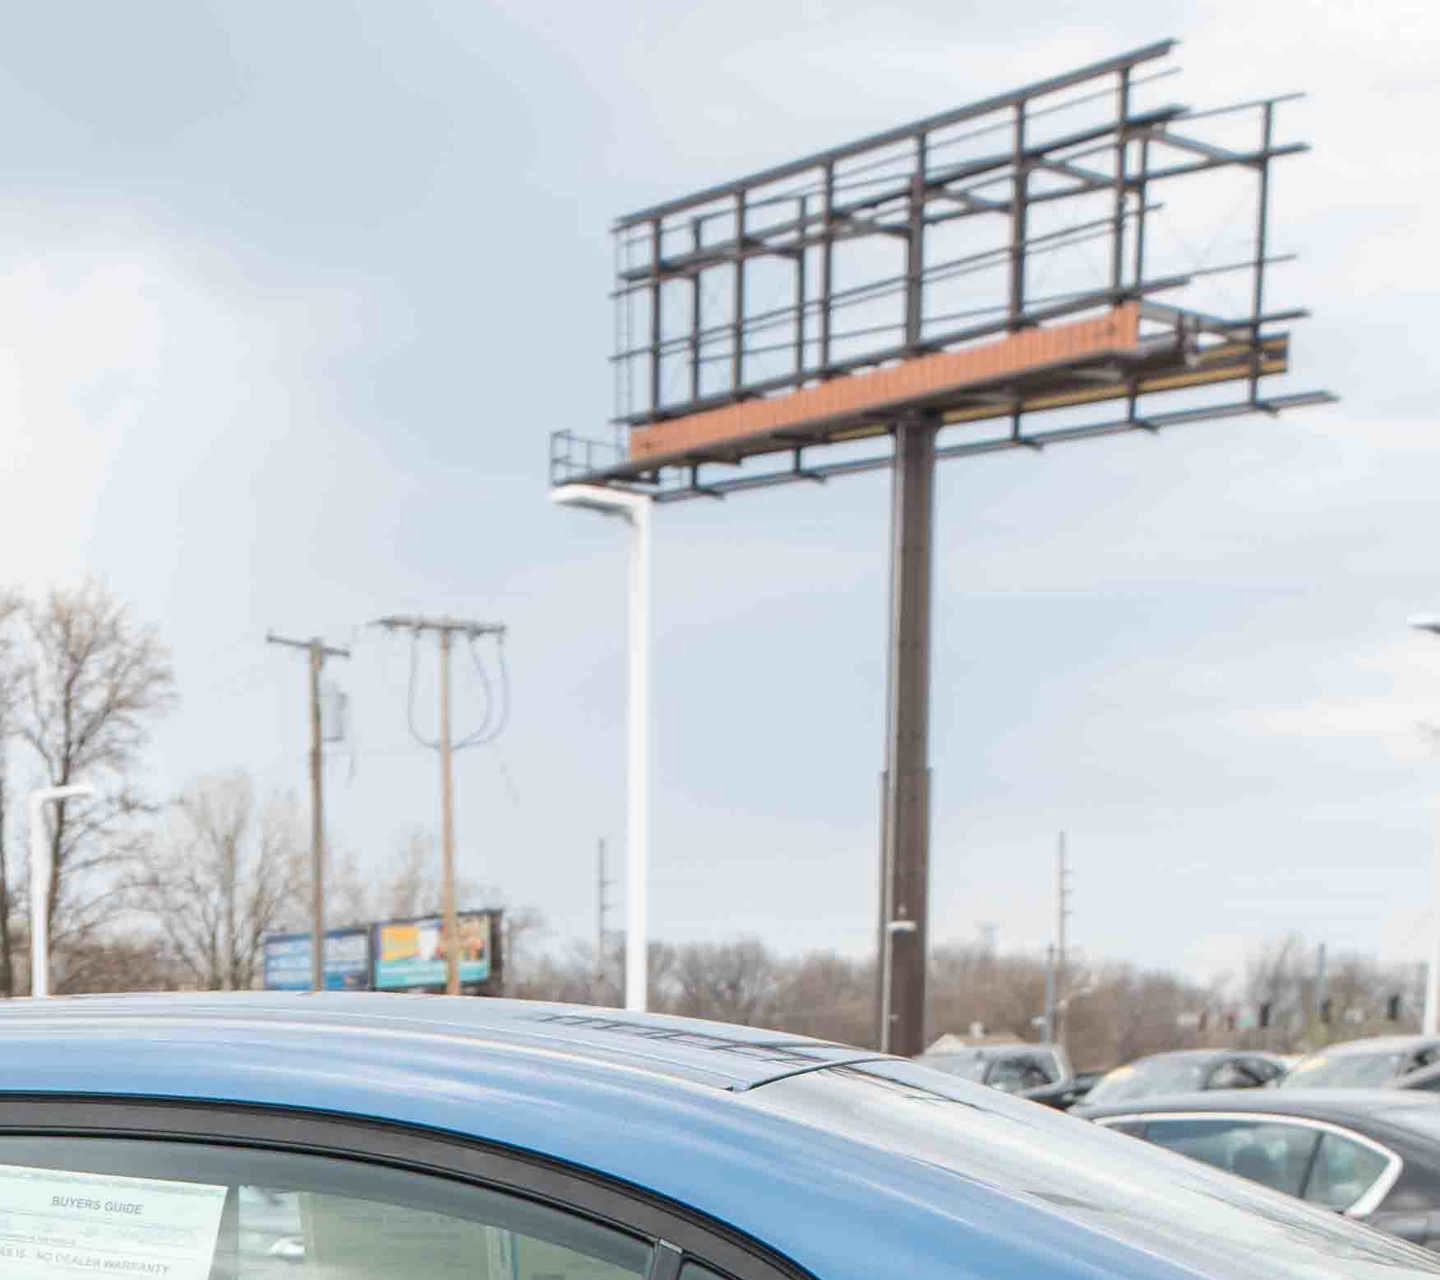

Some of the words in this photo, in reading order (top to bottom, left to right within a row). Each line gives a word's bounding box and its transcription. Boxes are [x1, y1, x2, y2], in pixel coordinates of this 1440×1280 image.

[51, 1195, 101, 1211] BUYERS
[104, 1200, 144, 1215] GUIDE
[104, 1258, 170, 1275] WARRANTY
